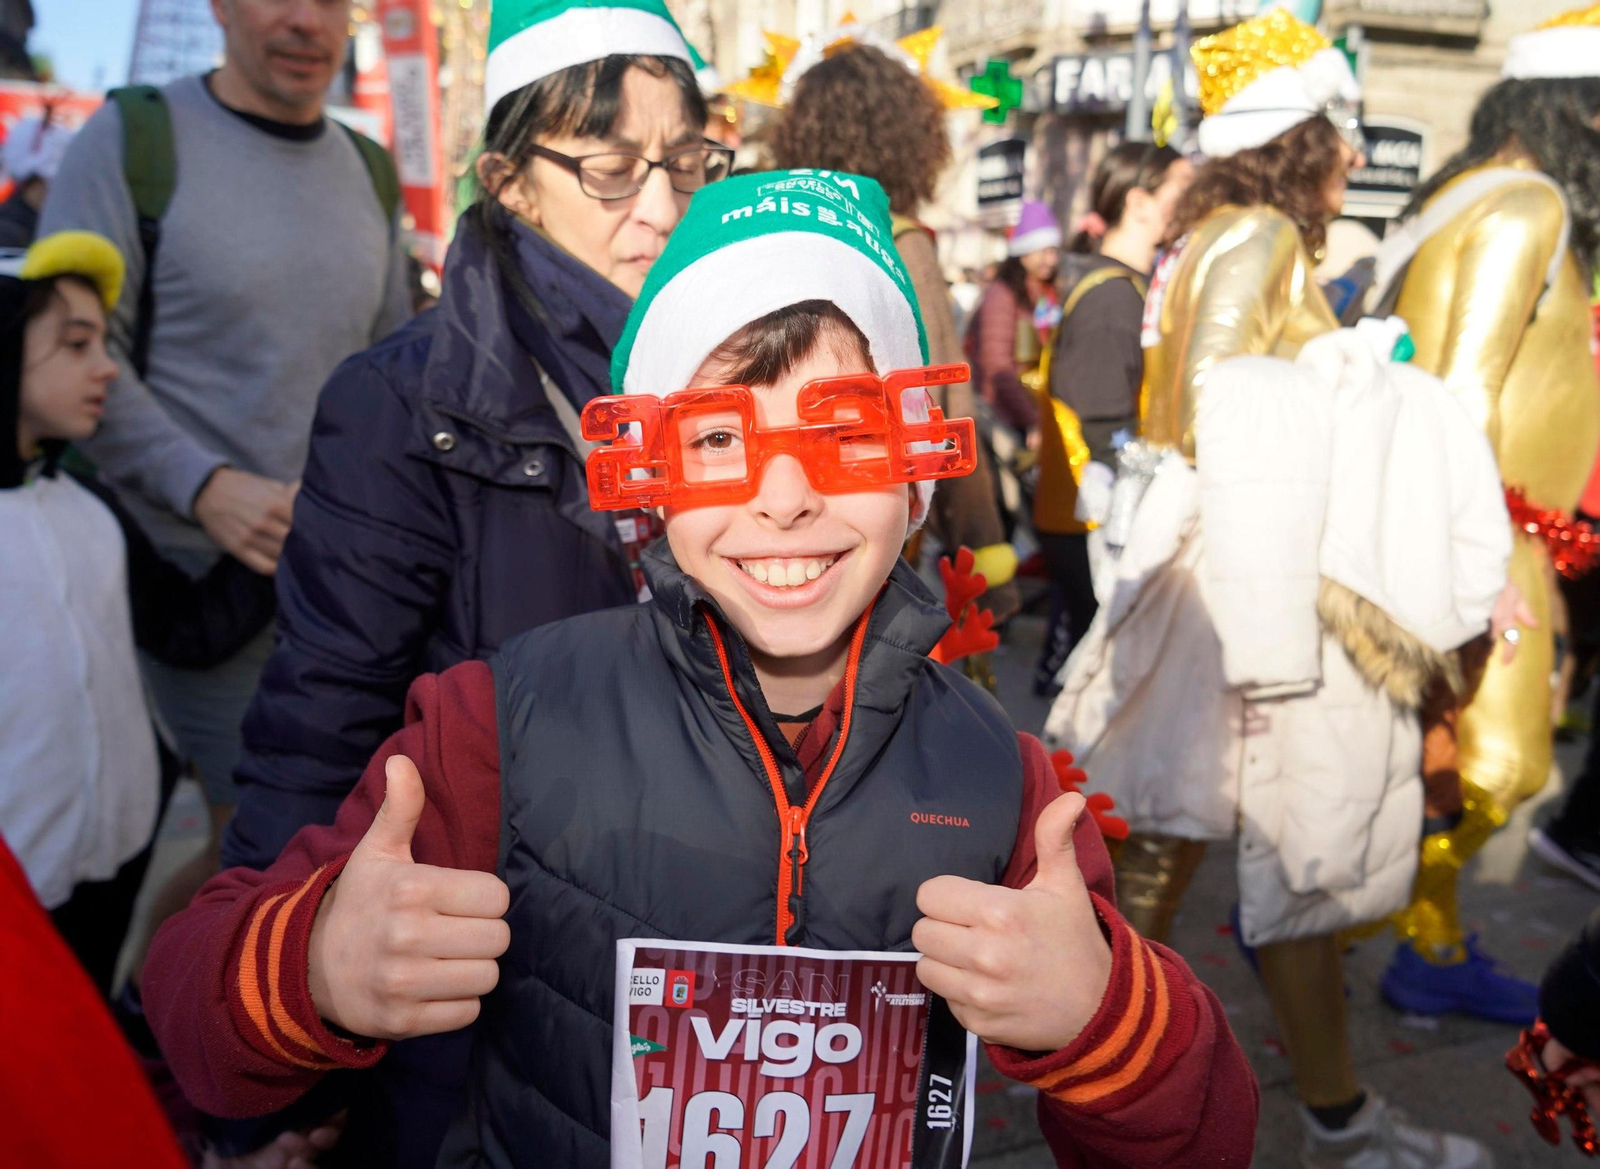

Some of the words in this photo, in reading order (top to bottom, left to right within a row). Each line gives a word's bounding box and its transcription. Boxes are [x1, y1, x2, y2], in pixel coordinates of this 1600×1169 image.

[910, 812, 970, 827] QUECHUA
[630, 975, 659, 985] ELLO
[732, 969, 849, 1002] SAN
[731, 997, 846, 1017] SILVESTRE
[691, 1013, 862, 1078] vigo
[926, 1074, 953, 1130] 1627
[638, 1086, 876, 1169] 1627
